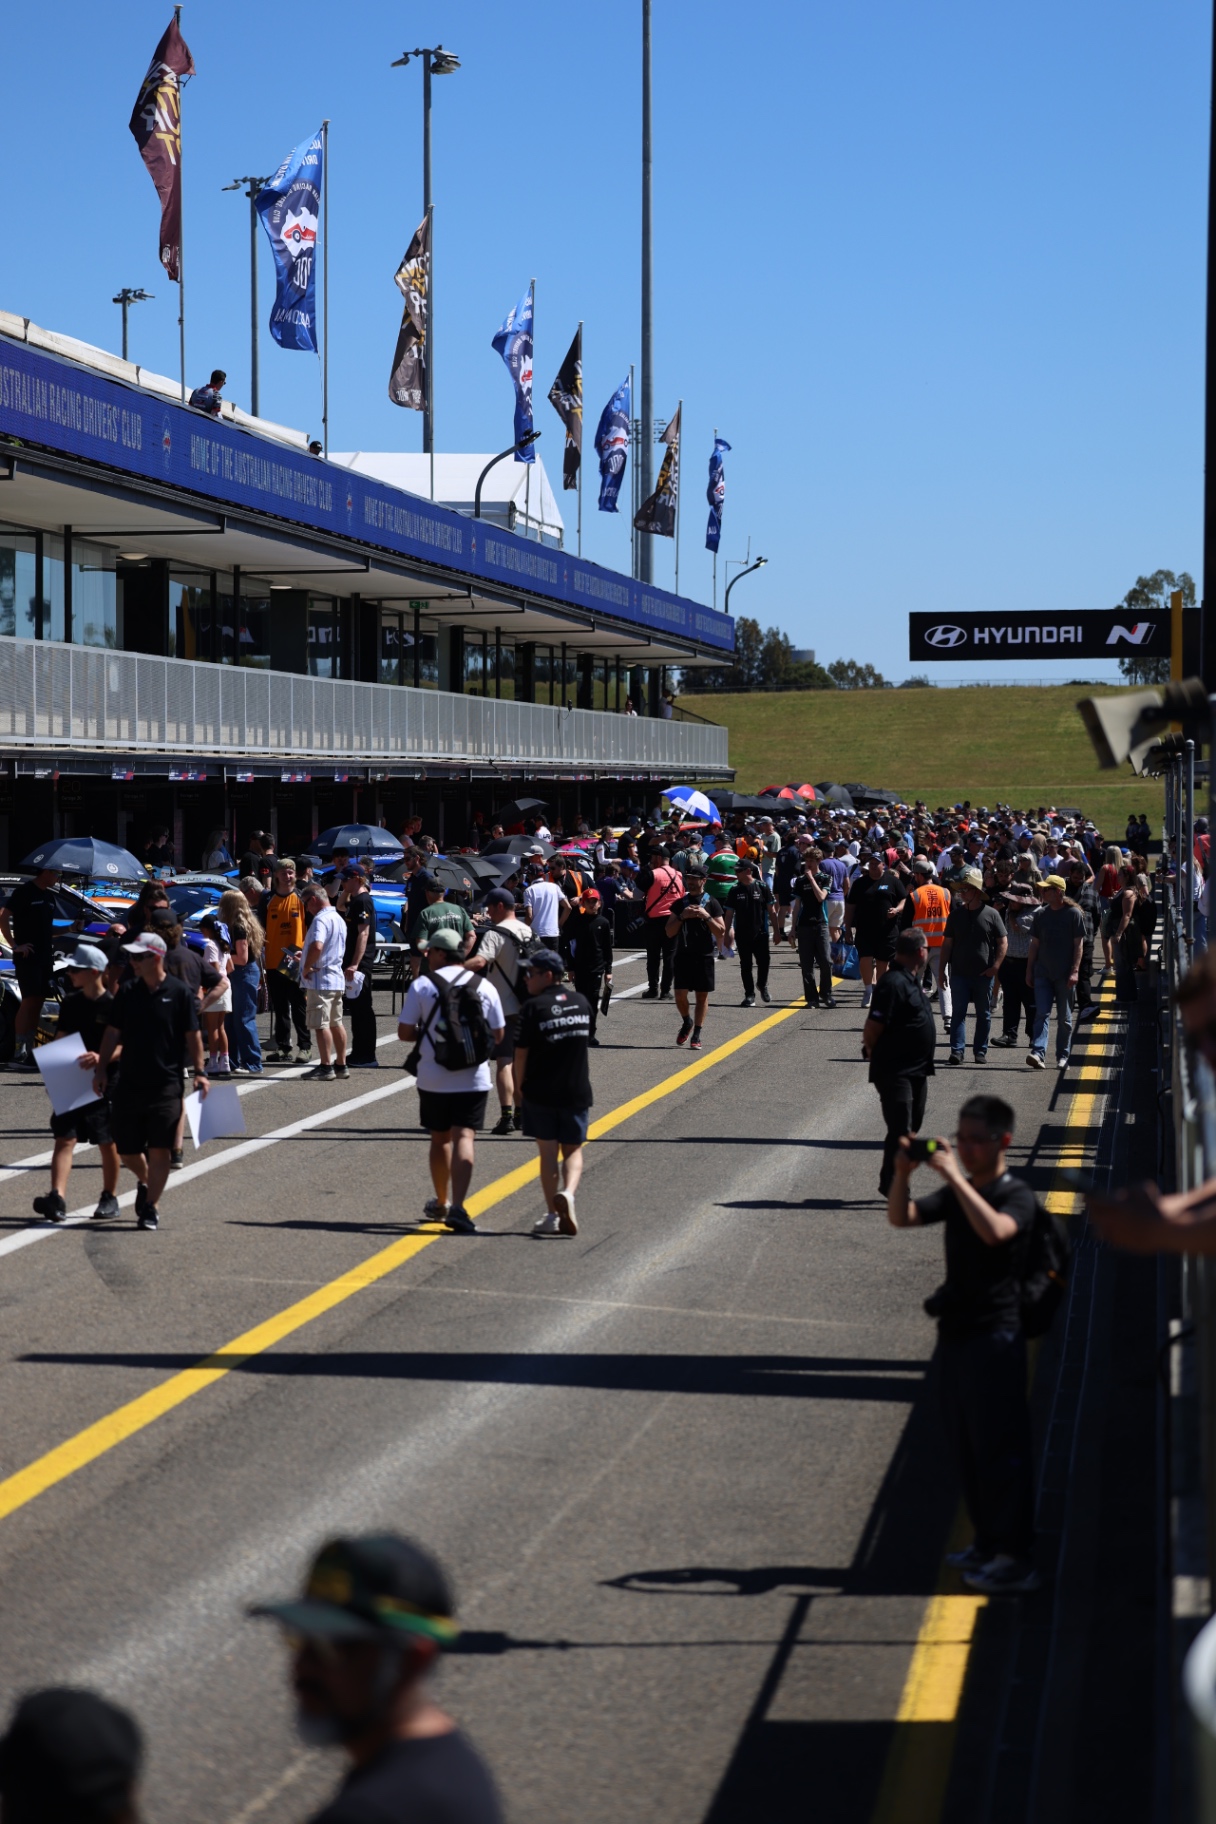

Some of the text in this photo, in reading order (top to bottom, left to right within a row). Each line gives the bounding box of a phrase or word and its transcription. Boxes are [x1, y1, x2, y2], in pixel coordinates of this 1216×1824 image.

[50, 383, 81, 431] RACING
[122, 408, 142, 451] CLUB
[191, 434, 209, 474] HOME
[212, 441, 219, 476] OF
[221, 444, 233, 481] THE
[974, 626, 1083, 644] HYUNDAI
